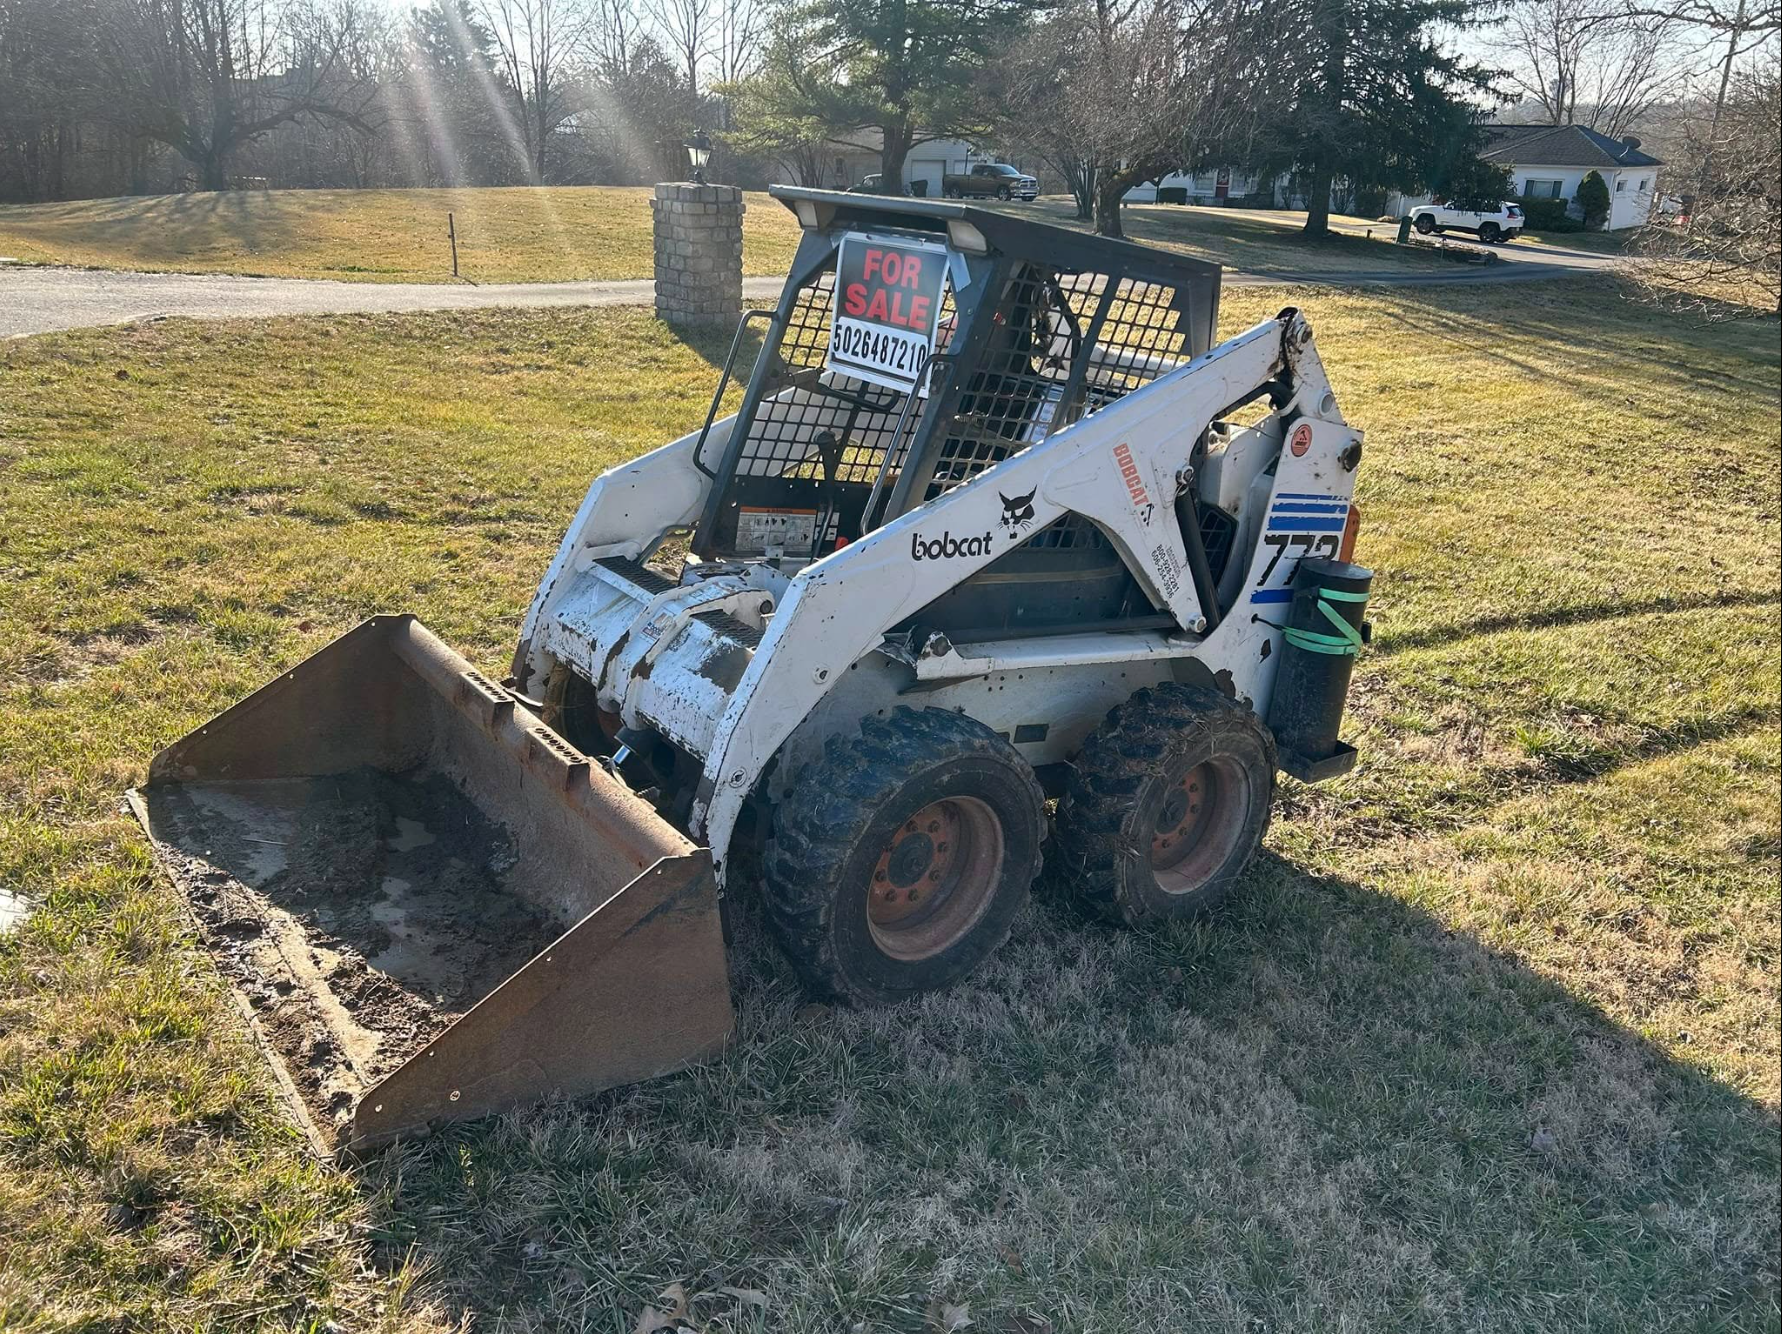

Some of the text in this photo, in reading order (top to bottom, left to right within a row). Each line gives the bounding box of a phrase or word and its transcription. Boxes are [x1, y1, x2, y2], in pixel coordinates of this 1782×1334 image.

[863, 249, 922, 289] FOR
[844, 283, 931, 330] SALE
[833, 324, 927, 373] 5026487210
[1112, 442, 1150, 507] BOBCAT
[911, 531, 993, 562] bobcat
